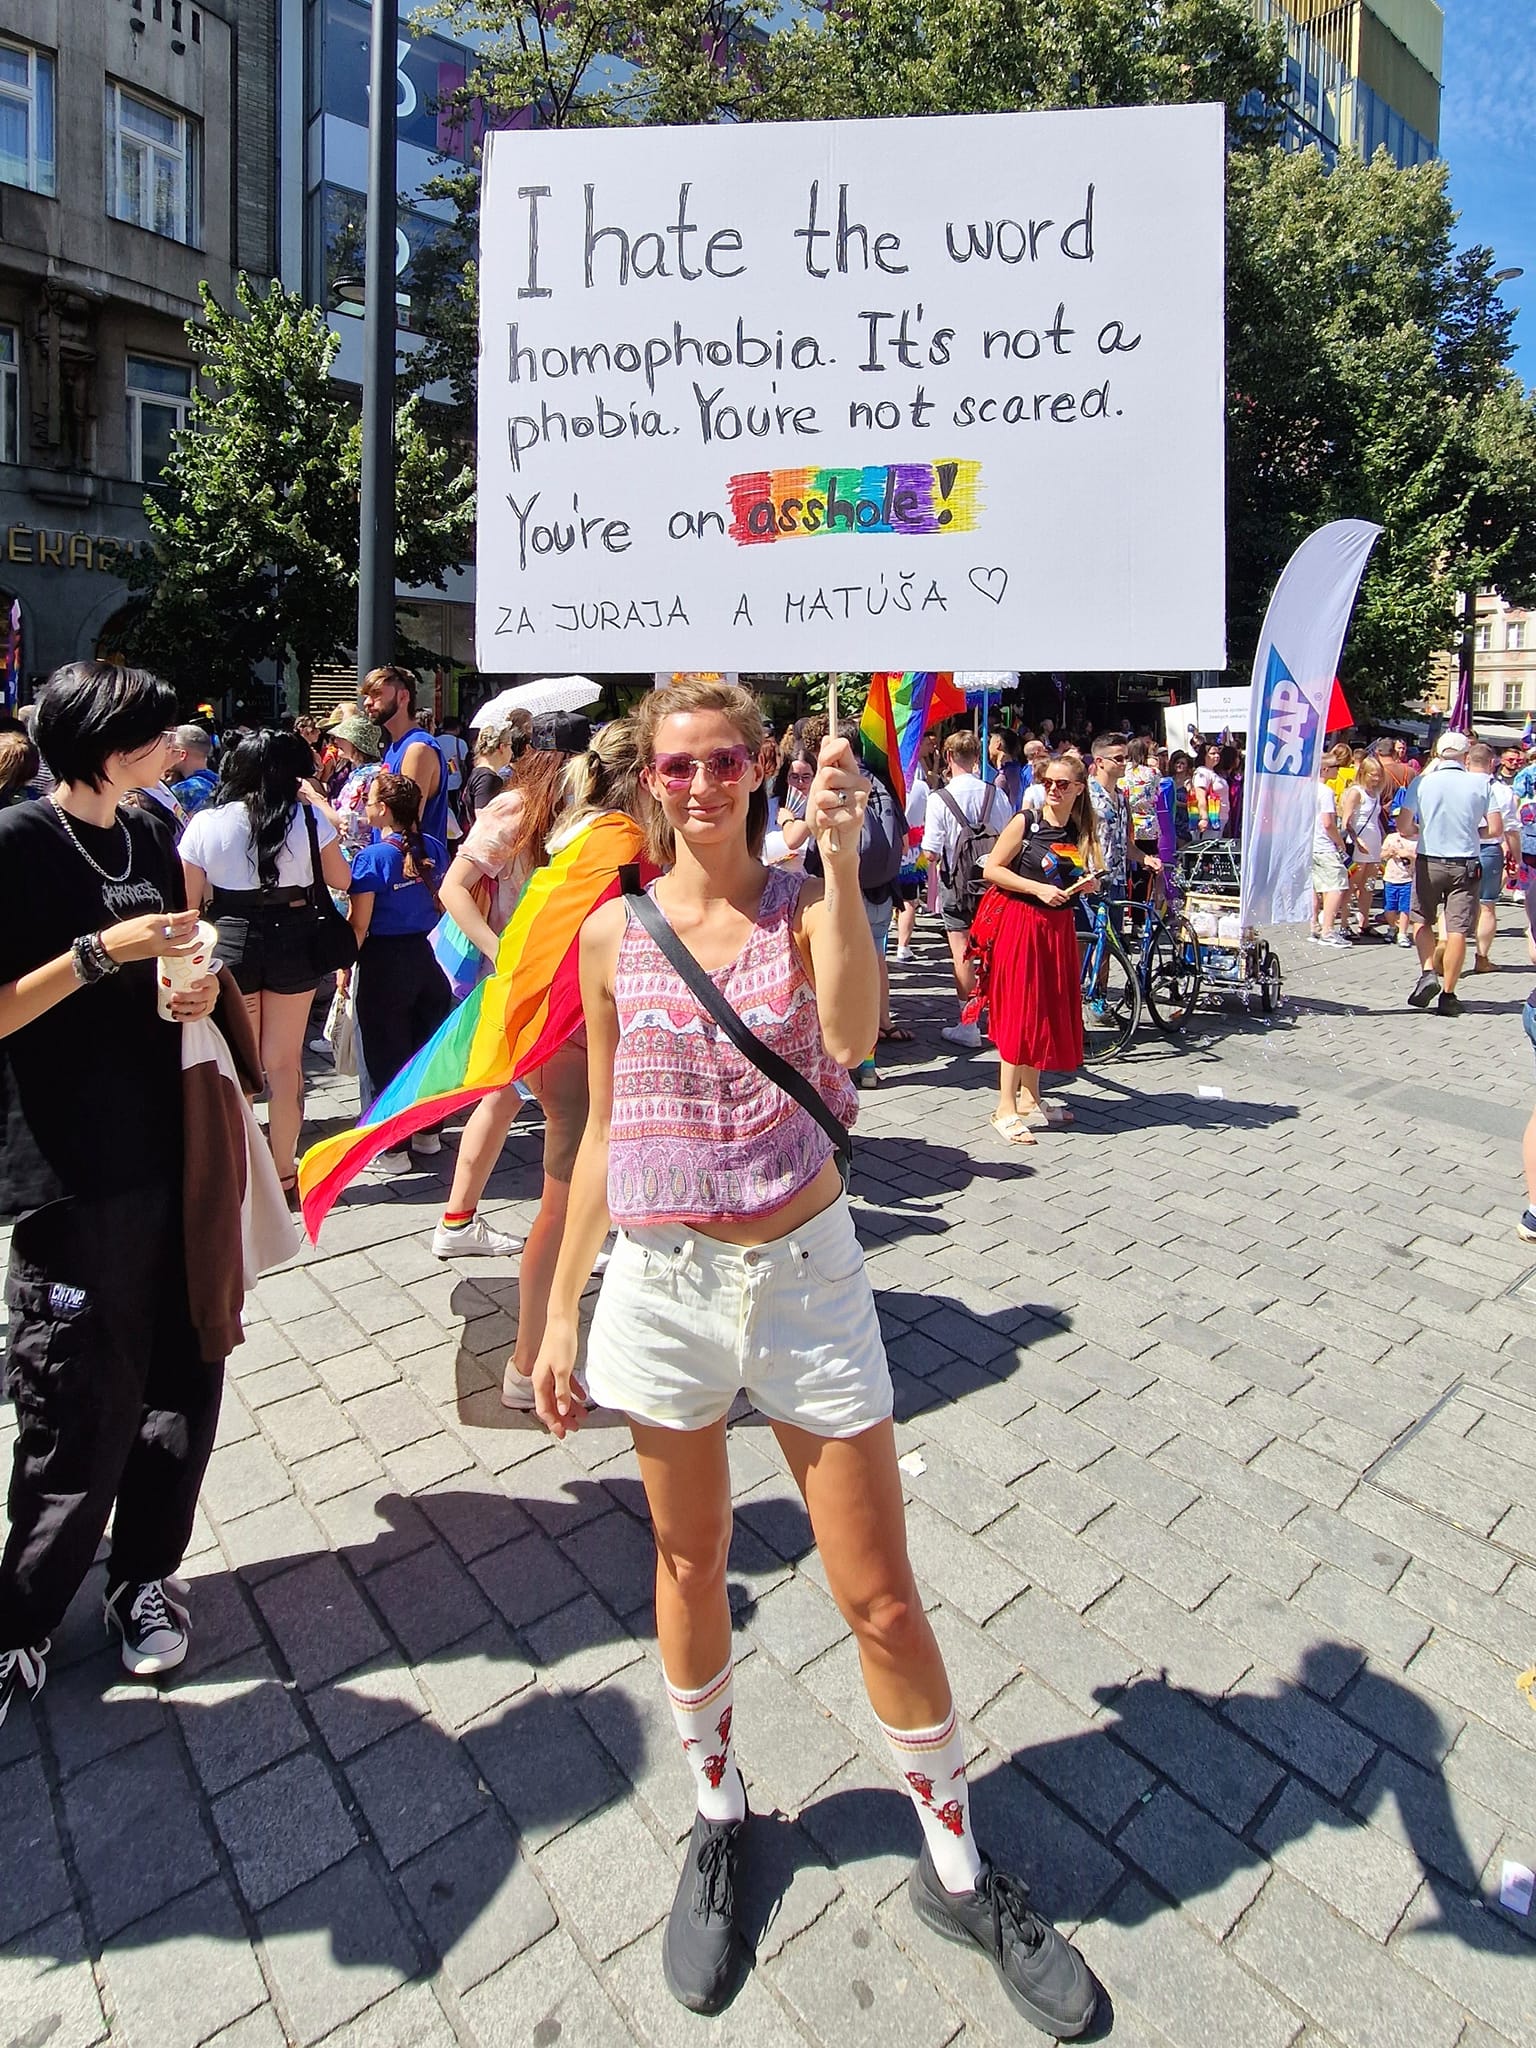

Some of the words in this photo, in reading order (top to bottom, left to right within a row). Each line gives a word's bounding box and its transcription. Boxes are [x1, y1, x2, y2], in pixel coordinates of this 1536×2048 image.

[517, 185, 553, 300] I
[583, 182, 748, 289] hate
[793, 179, 910, 280] the
[945, 182, 1096, 265] word
[507, 315, 837, 396] homophobia.
[857, 302, 957, 372] It's
[983, 301, 1076, 360] not
[1097, 320, 1142, 355] a
[692, 380, 823, 445] You're
[849, 384, 937, 430] not
[952, 379, 1123, 428] scared.
[505, 491, 633, 572] You're
[668, 510, 725, 540] an
[748, 461, 959, 535] asshole!
[494, 606, 536, 636] ZA
[551, 594, 690, 631] JURAJA
[733, 593, 753, 627] A
[785, 569, 949, 625] MATÚŠA
[1263, 679, 1310, 775] SAP
